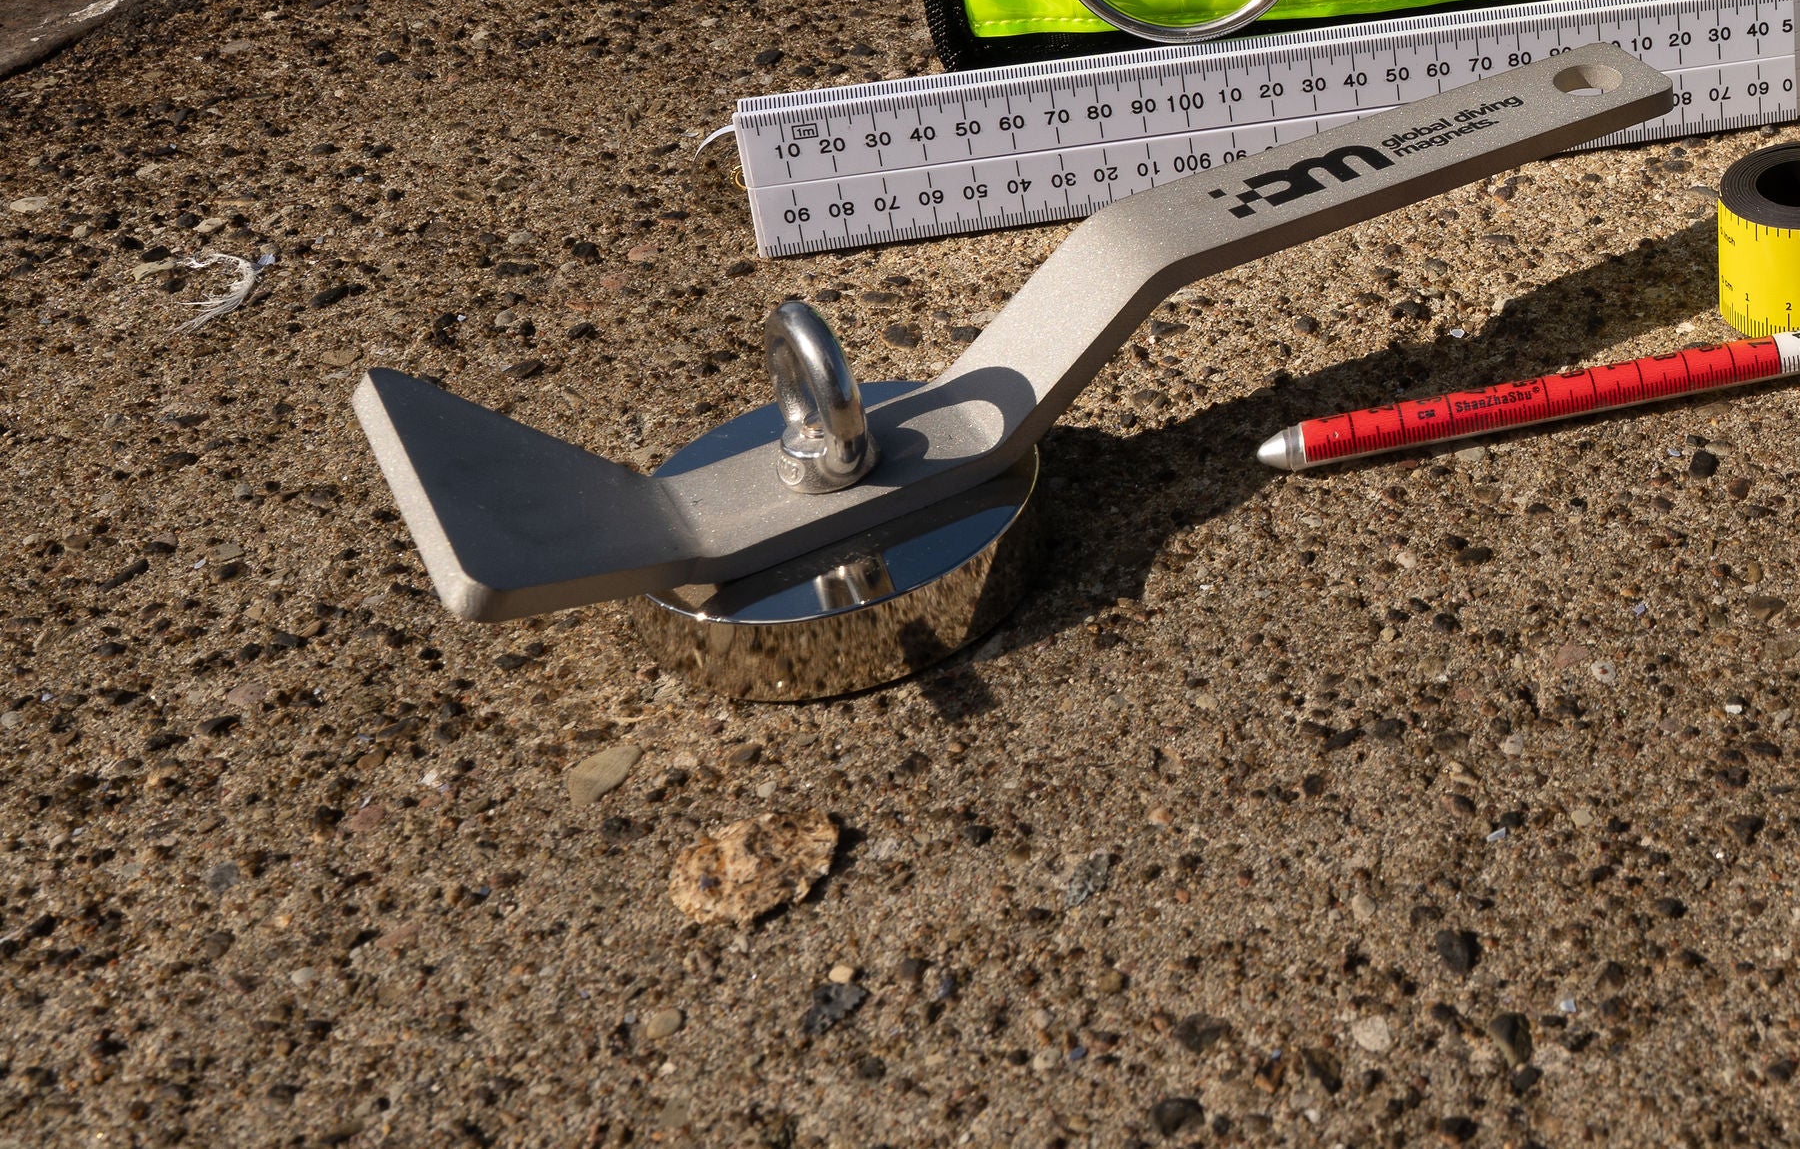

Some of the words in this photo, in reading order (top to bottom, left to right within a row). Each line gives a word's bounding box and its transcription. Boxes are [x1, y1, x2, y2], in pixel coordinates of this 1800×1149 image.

[775, 143, 800, 159] 10
[820, 138, 846, 154] 20
[865, 132, 891, 147] 30
[910, 126, 936, 142] 40
[955, 120, 981, 136] 50
[999, 115, 1025, 131] 60
[1044, 109, 1070, 126] 70
[1087, 103, 1113, 120] 80
[1131, 98, 1156, 114] 90
[1167, 92, 1204, 112] 100
[1219, 87, 1242, 103] 10
[1259, 82, 1284, 99] 20
[1302, 77, 1327, 93] 30
[1343, 72, 1368, 88] 40
[1386, 66, 1410, 83] 50
[1426, 61, 1451, 77] 60
[1468, 56, 1493, 72] 70
[1508, 51, 1532, 68] 80
[1630, 37, 1653, 51] 10
[1668, 32, 1692, 47] 20
[1708, 26, 1731, 42] 30
[1746, 21, 1769, 36] 40
[1782, 19, 1793, 32] 5
[1747, 82, 1770, 97] 60
[1783, 78, 1793, 92] 0
[1673, 91, 1692, 107] 80
[1708, 86, 1732, 102] 70
[1381, 117, 1453, 150] global
[1454, 95, 1524, 122] diving
[796, 127, 815, 138] 1m
[1392, 119, 1500, 157] magnets.
[1137, 161, 1161, 177] 10
[1173, 152, 1212, 173] 900
[1051, 172, 1077, 188] 30
[1093, 166, 1119, 183] 20
[963, 184, 988, 200] 50
[1006, 178, 1032, 194] 40
[874, 195, 901, 212] 70
[918, 190, 944, 206] 60
[783, 208, 811, 224] 90
[828, 201, 855, 218] 80
[1745, 292, 1750, 302] 1
[1785, 302, 1792, 311] 2
